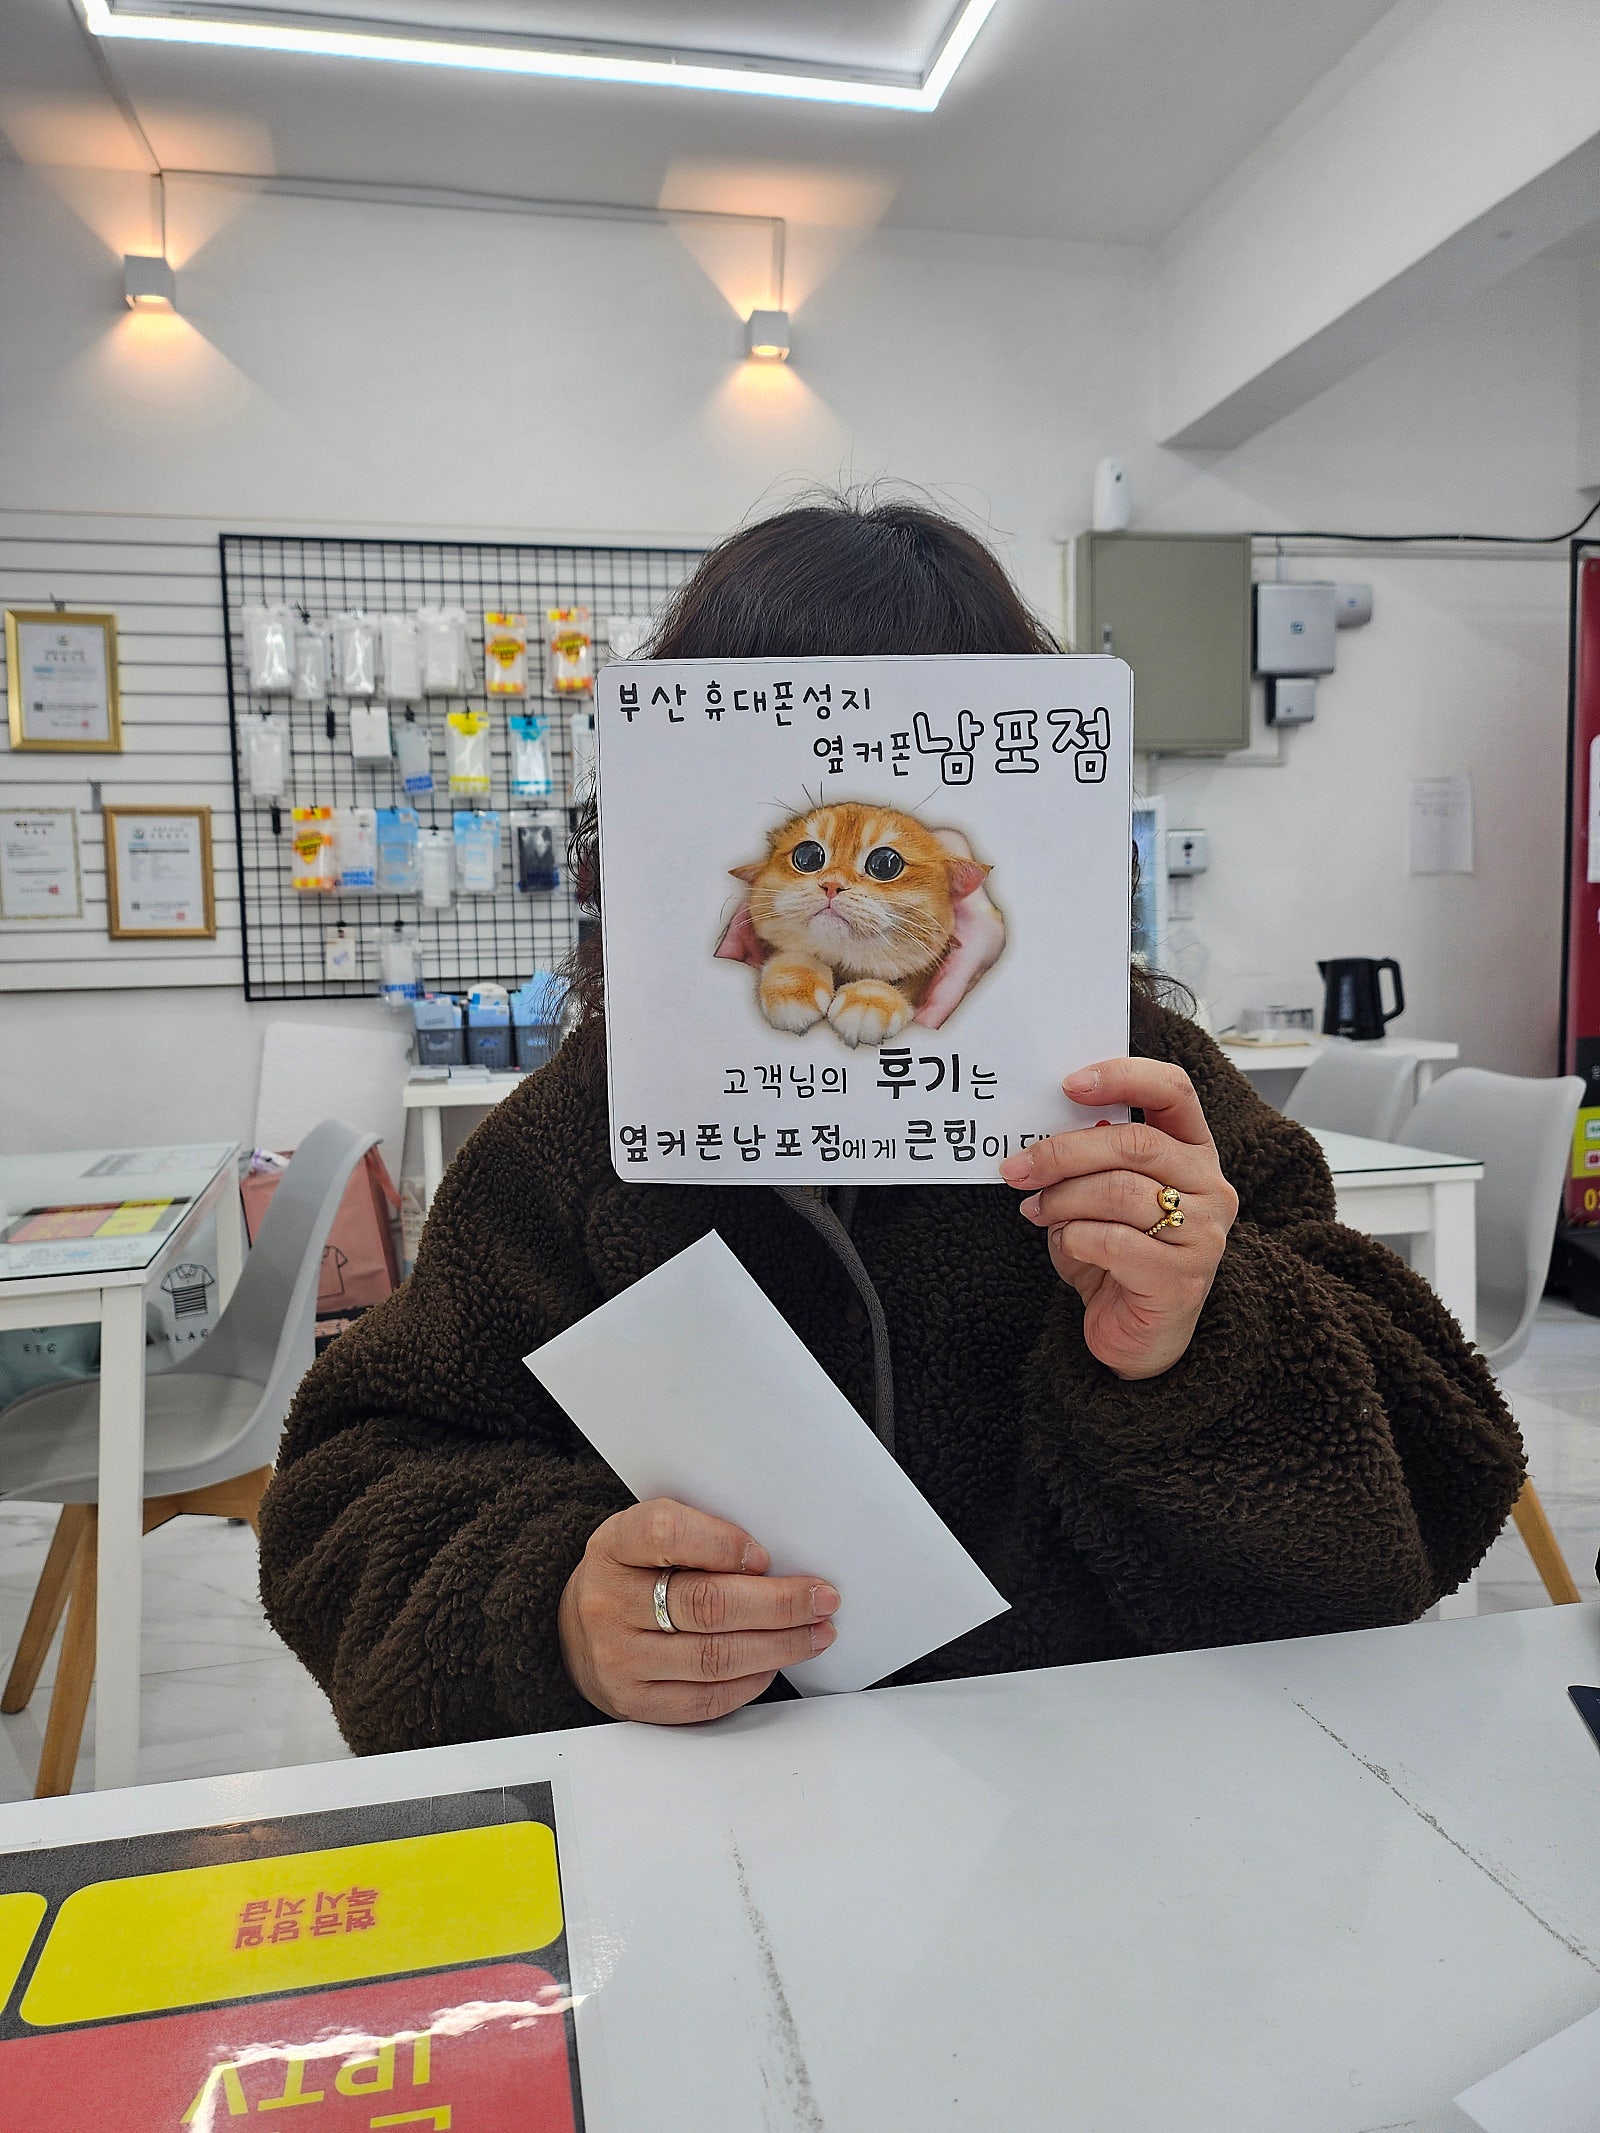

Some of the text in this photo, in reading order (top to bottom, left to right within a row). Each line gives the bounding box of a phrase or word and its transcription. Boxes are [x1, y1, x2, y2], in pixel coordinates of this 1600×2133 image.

[619, 680, 870, 727] 부산 휴대폰성지
[723, 1047, 998, 1100] 고객님의 후기는
[234, 1908, 376, 1949] 현금 당일
[239, 1887, 379, 1924] 즉시 지급
[180, 2029, 431, 2123] IPTV
